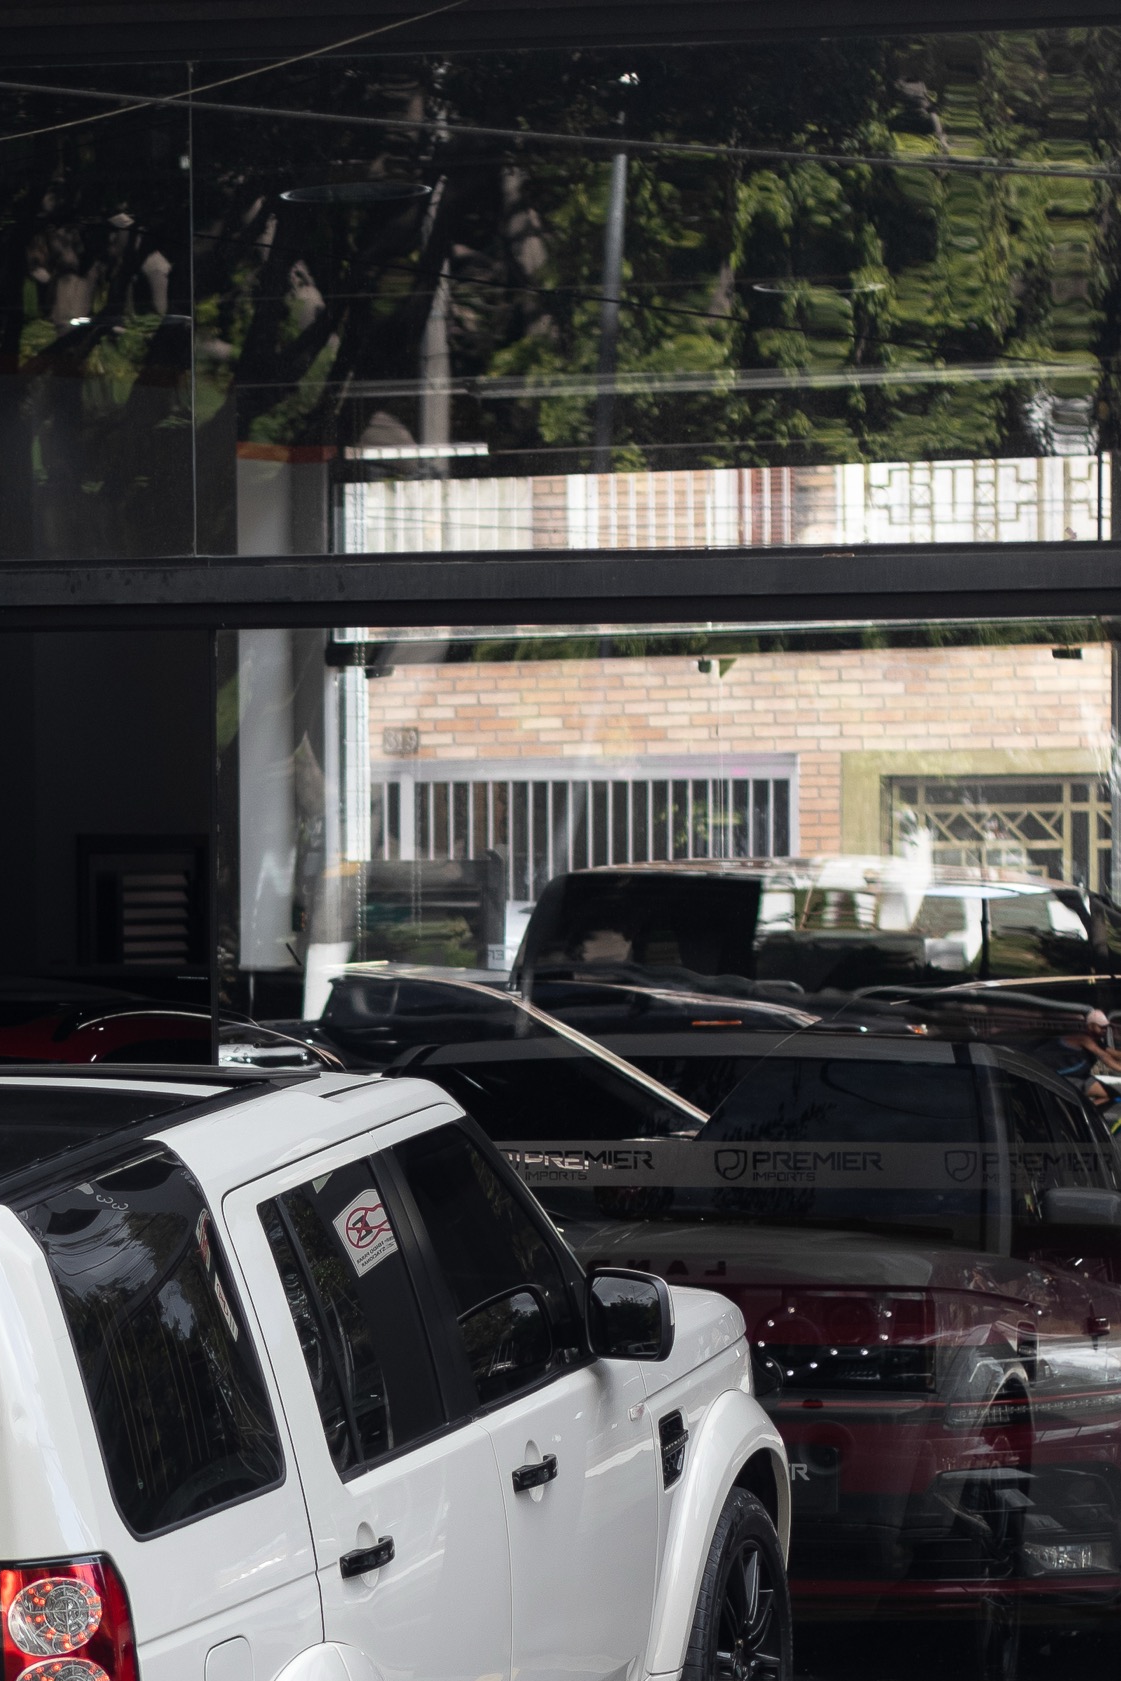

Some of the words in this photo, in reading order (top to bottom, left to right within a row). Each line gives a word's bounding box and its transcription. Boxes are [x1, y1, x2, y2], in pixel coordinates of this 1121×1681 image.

[524, 1149, 656, 1171] PREMIER
[752, 1151, 884, 1171] PREMIER
[524, 1171, 588, 1181] IMPORTS
[752, 1171, 816, 1182] IMPORTS
